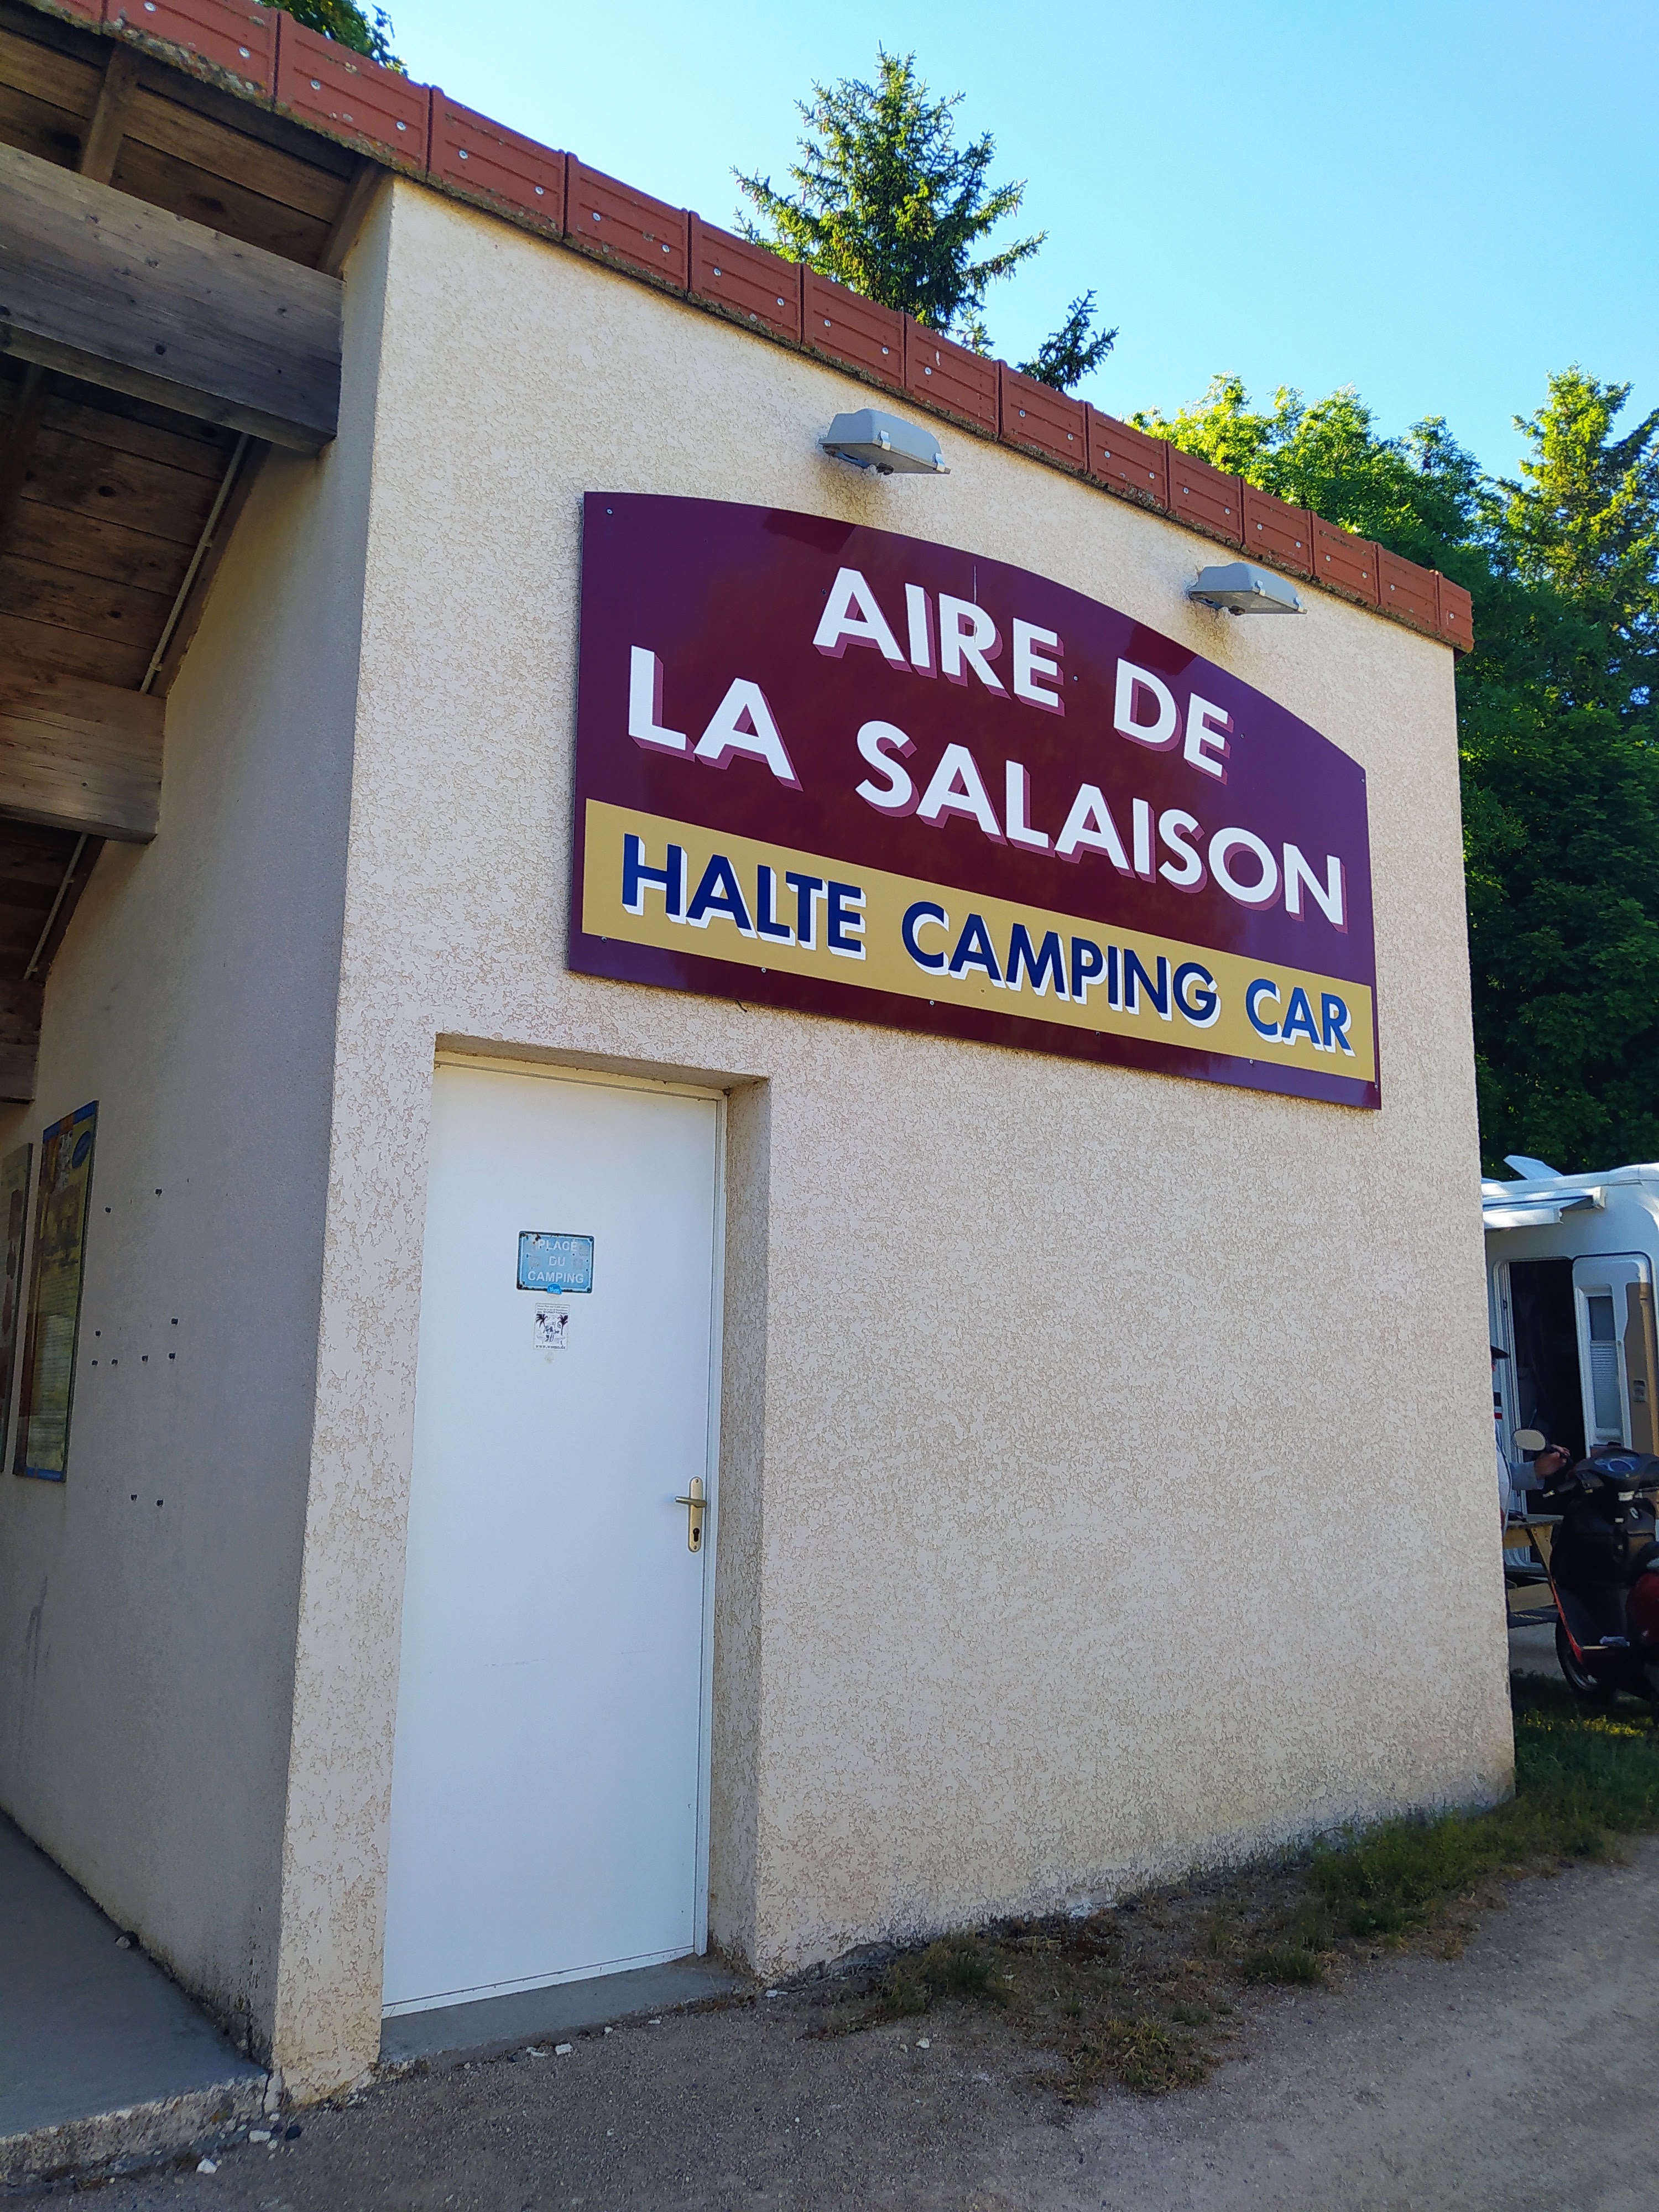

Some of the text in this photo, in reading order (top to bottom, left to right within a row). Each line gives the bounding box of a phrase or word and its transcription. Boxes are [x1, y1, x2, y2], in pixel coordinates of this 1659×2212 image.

[813, 567, 1230, 780] AIRE DE
[628, 645, 1344, 928] LA SALAISON
[622, 834, 1353, 1055] HALTE CAMPING CAR
[528, 1271, 584, 1284] CAMPING
[538, 1239, 577, 1251] PLACE
[549, 1256, 566, 1266] DU
